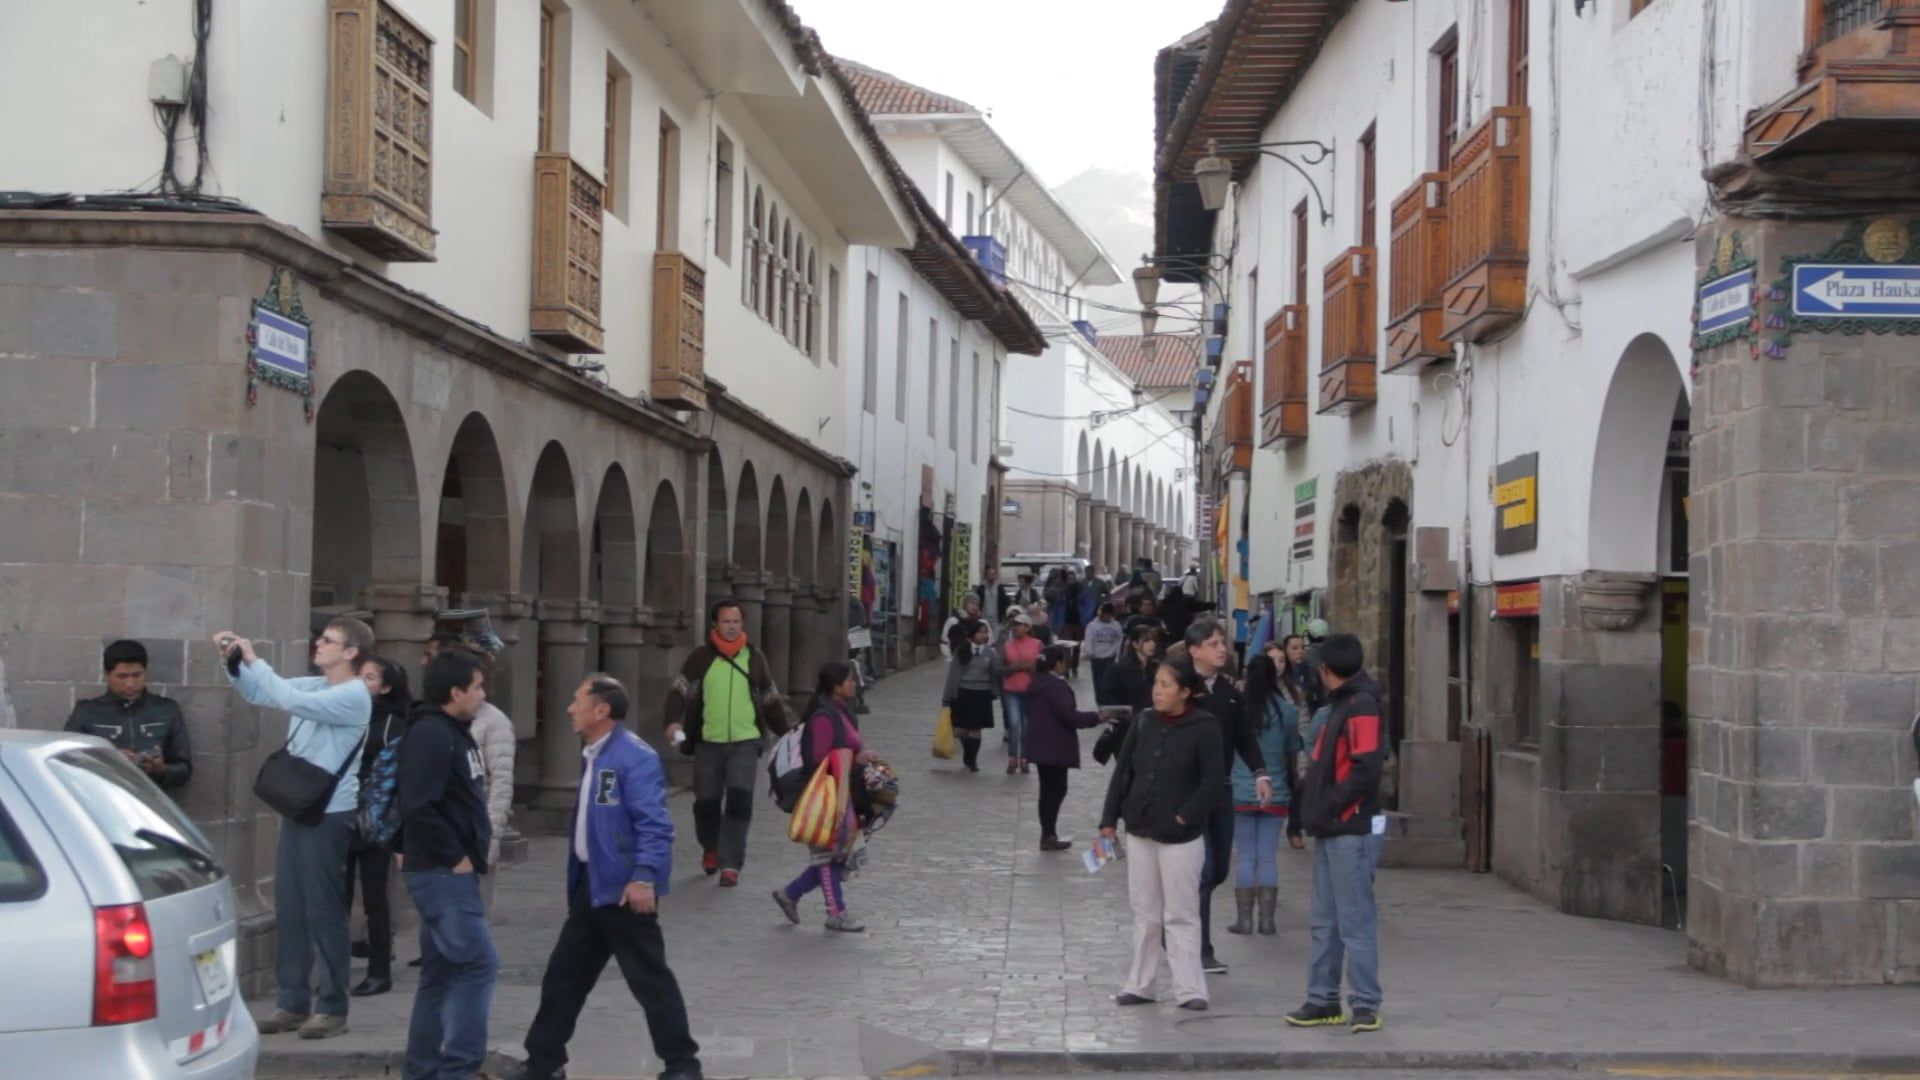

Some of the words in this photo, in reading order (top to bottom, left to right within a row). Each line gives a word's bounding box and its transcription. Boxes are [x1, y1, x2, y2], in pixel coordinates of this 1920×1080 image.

[1826, 281, 1865, 297] Plaza
[1872, 281, 1920, 298] Hauka
[595, 768, 620, 806] F
